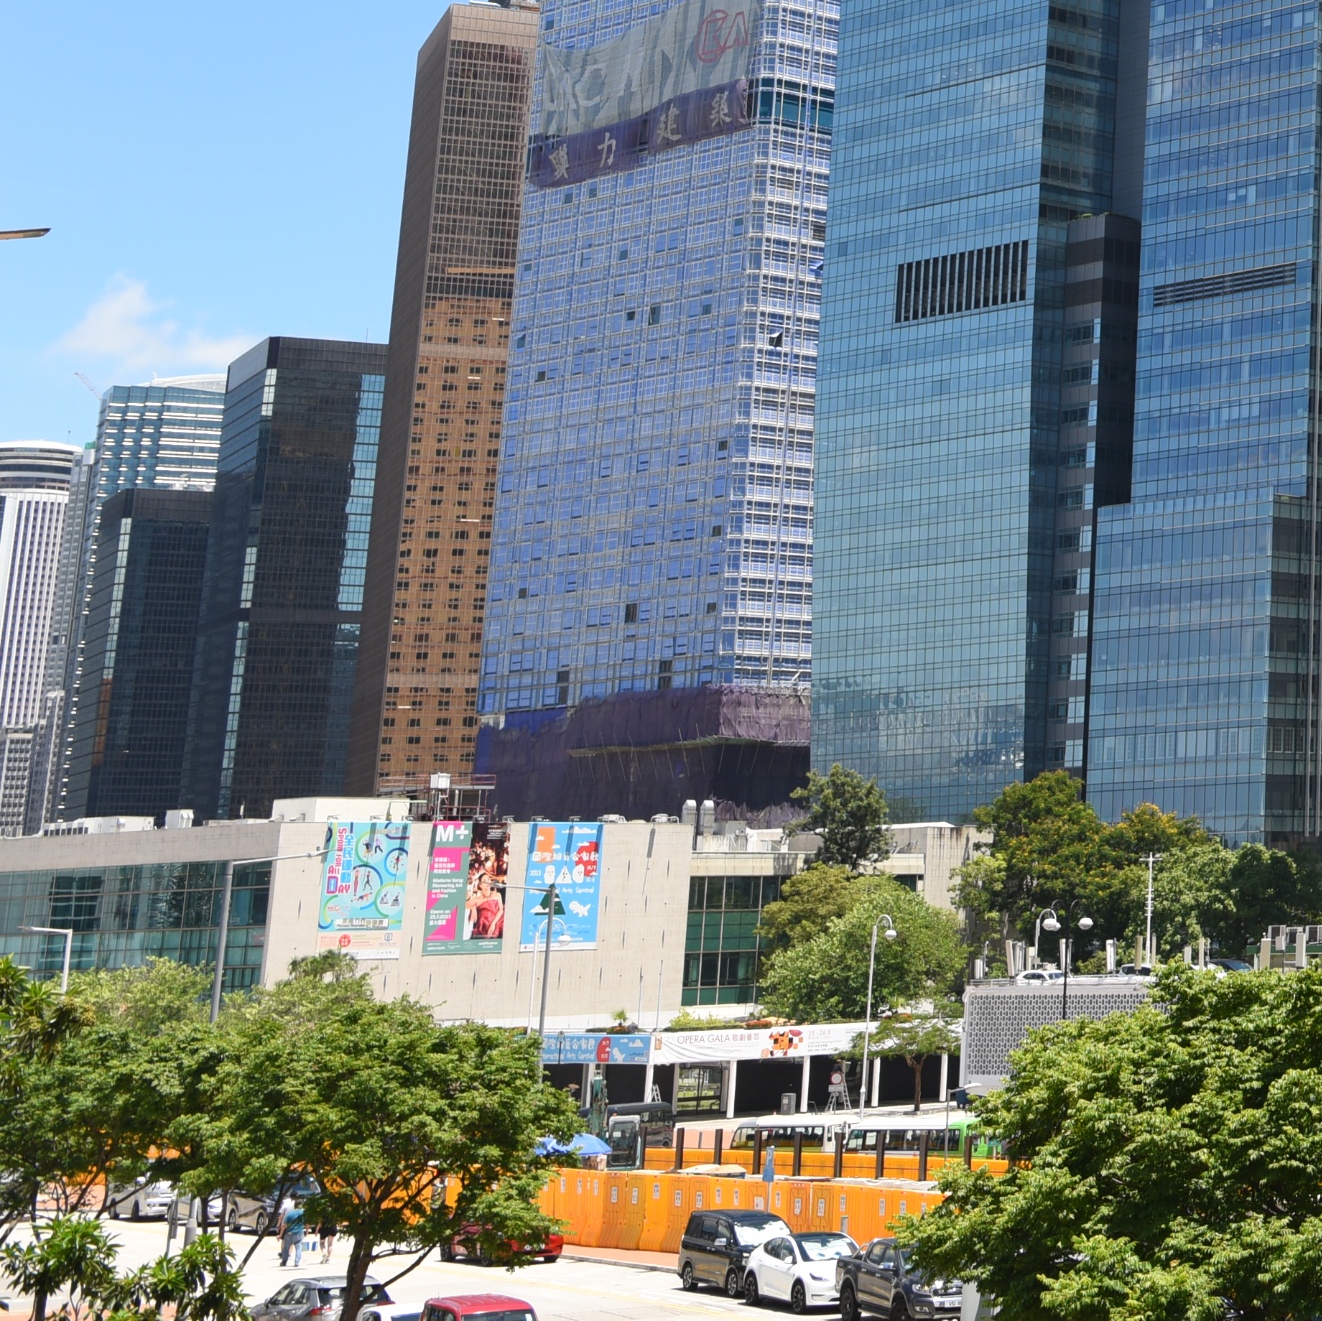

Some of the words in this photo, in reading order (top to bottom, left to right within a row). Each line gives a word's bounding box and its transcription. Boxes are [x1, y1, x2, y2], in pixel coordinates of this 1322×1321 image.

[436, 825, 469, 842] M+
[677, 1034, 706, 1045] OPERA
[707, 1034, 731, 1044] GALA
